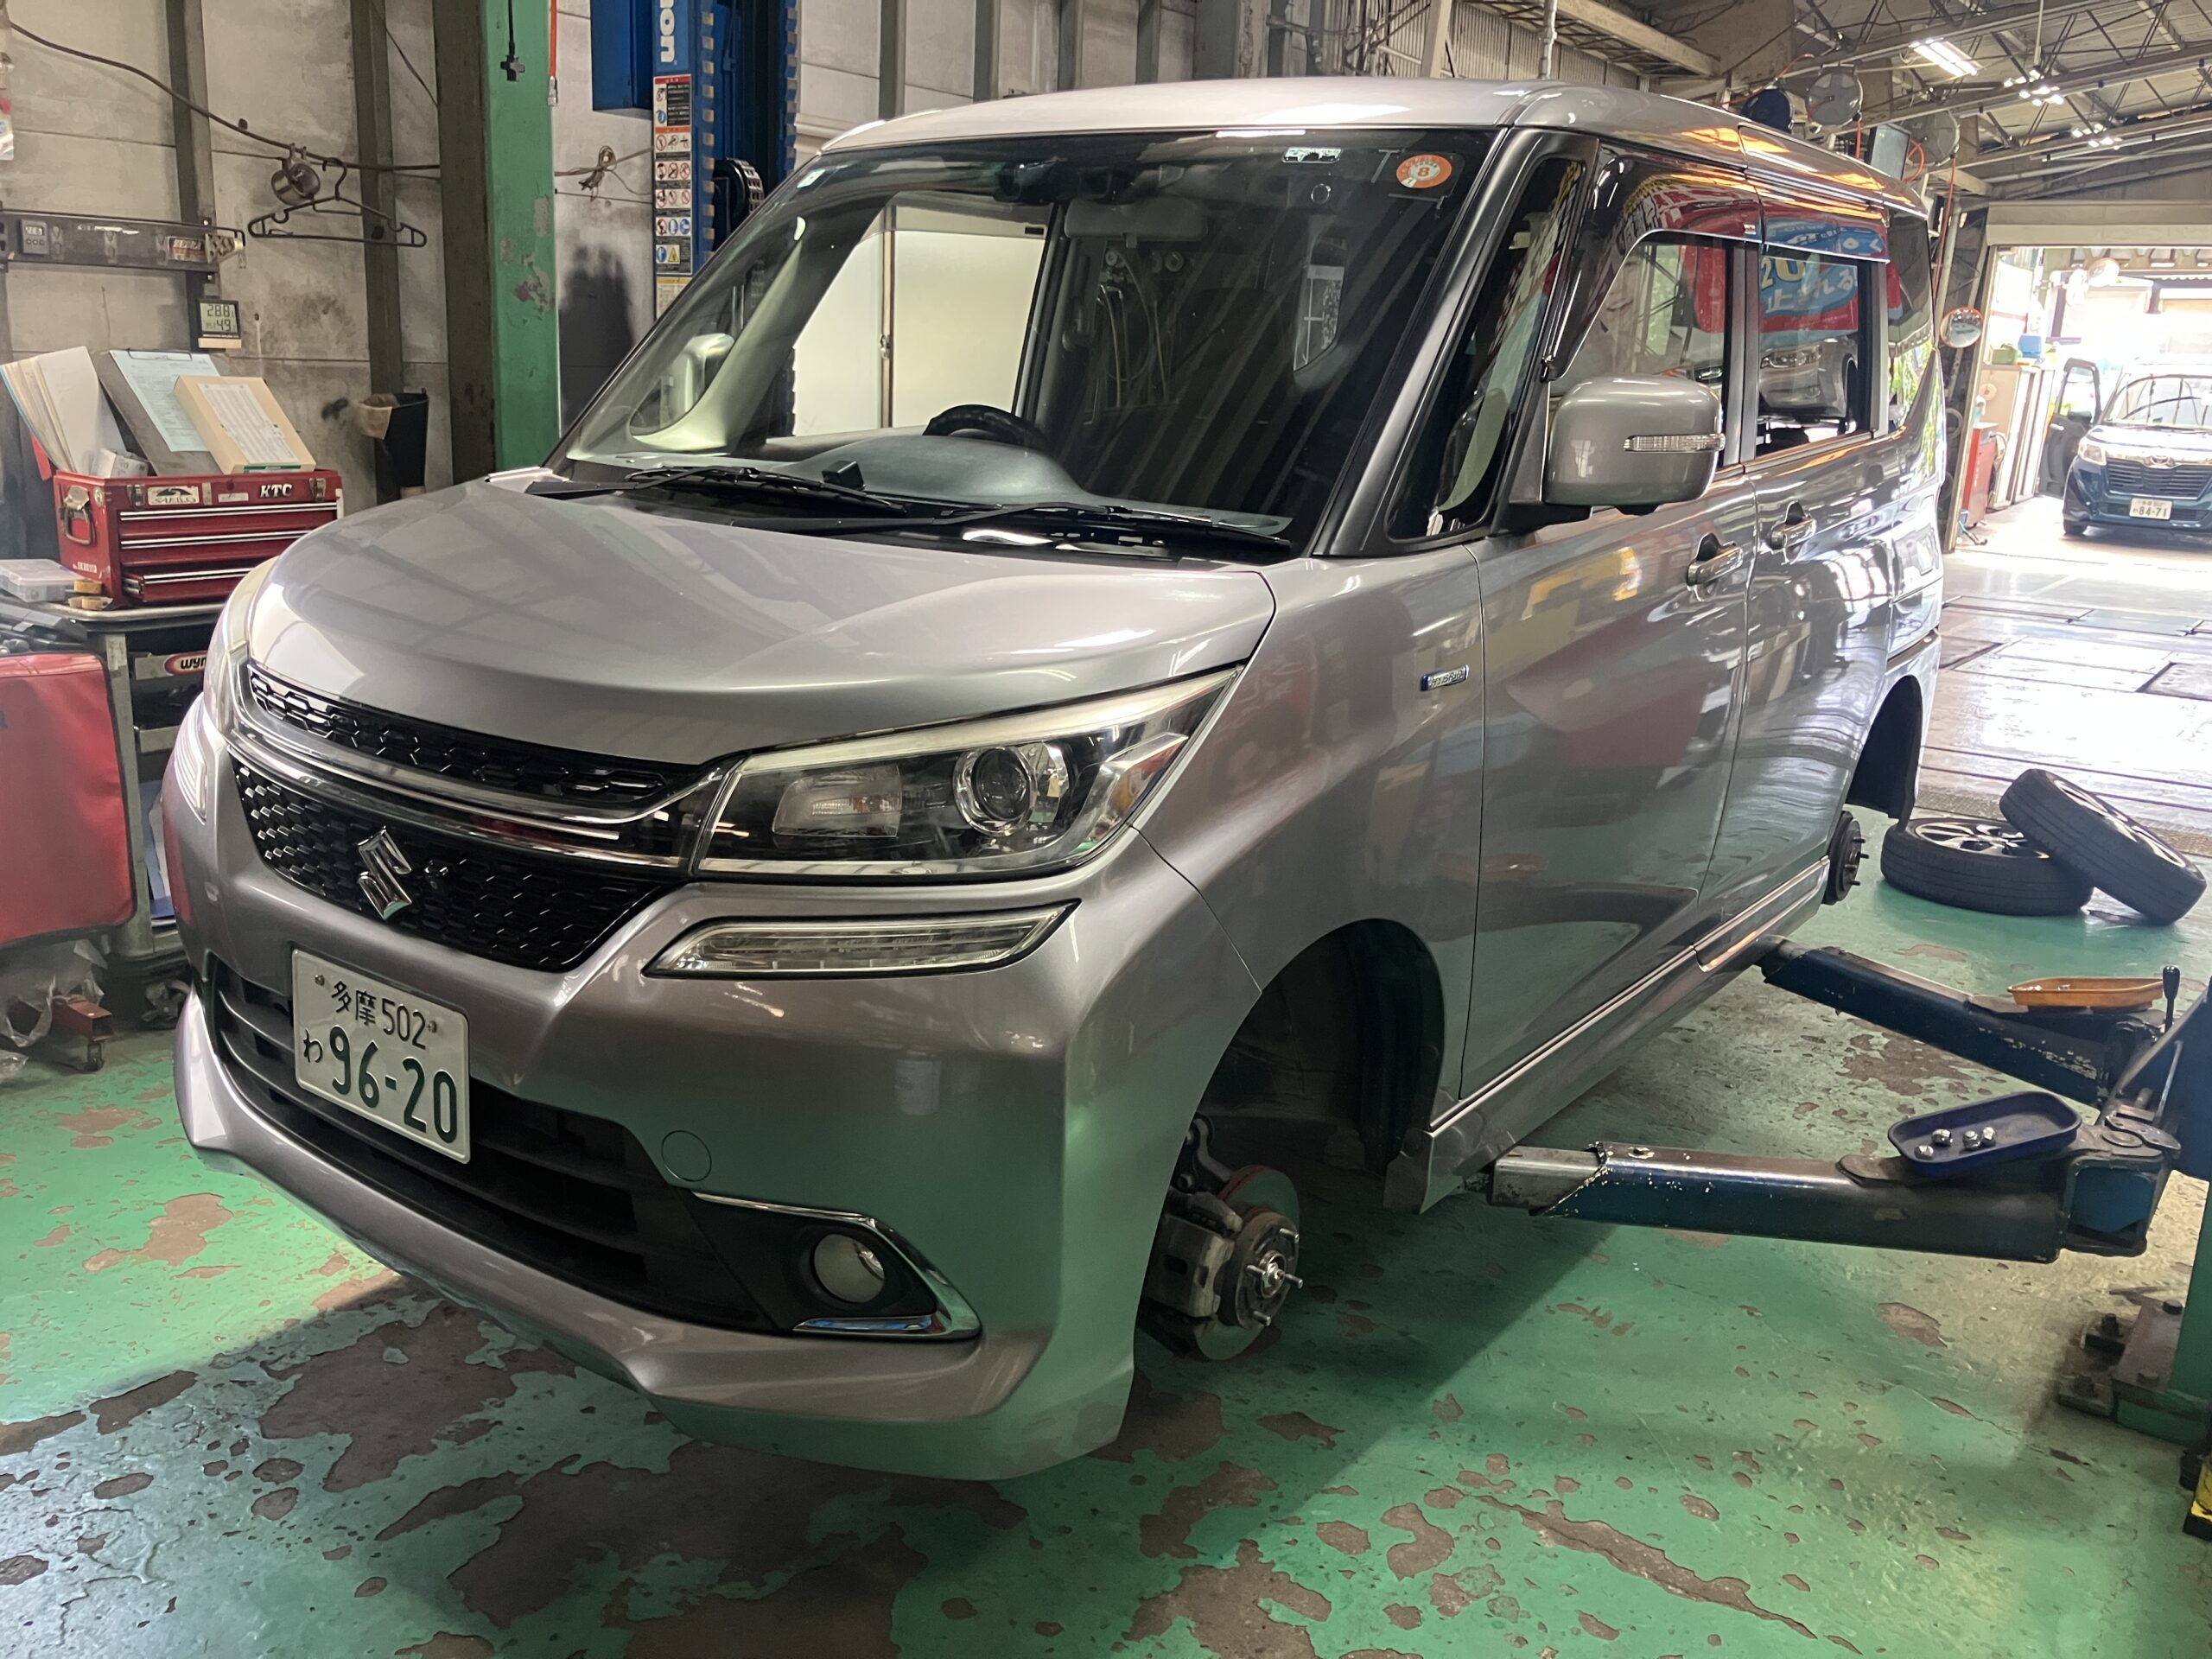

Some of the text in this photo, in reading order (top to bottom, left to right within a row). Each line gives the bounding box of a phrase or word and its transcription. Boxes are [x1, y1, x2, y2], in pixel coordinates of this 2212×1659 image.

[260, 484, 292, 499] KTC
[2139, 506, 2167, 518] 84-71
[302, 1025, 458, 1144] わ 96-20
